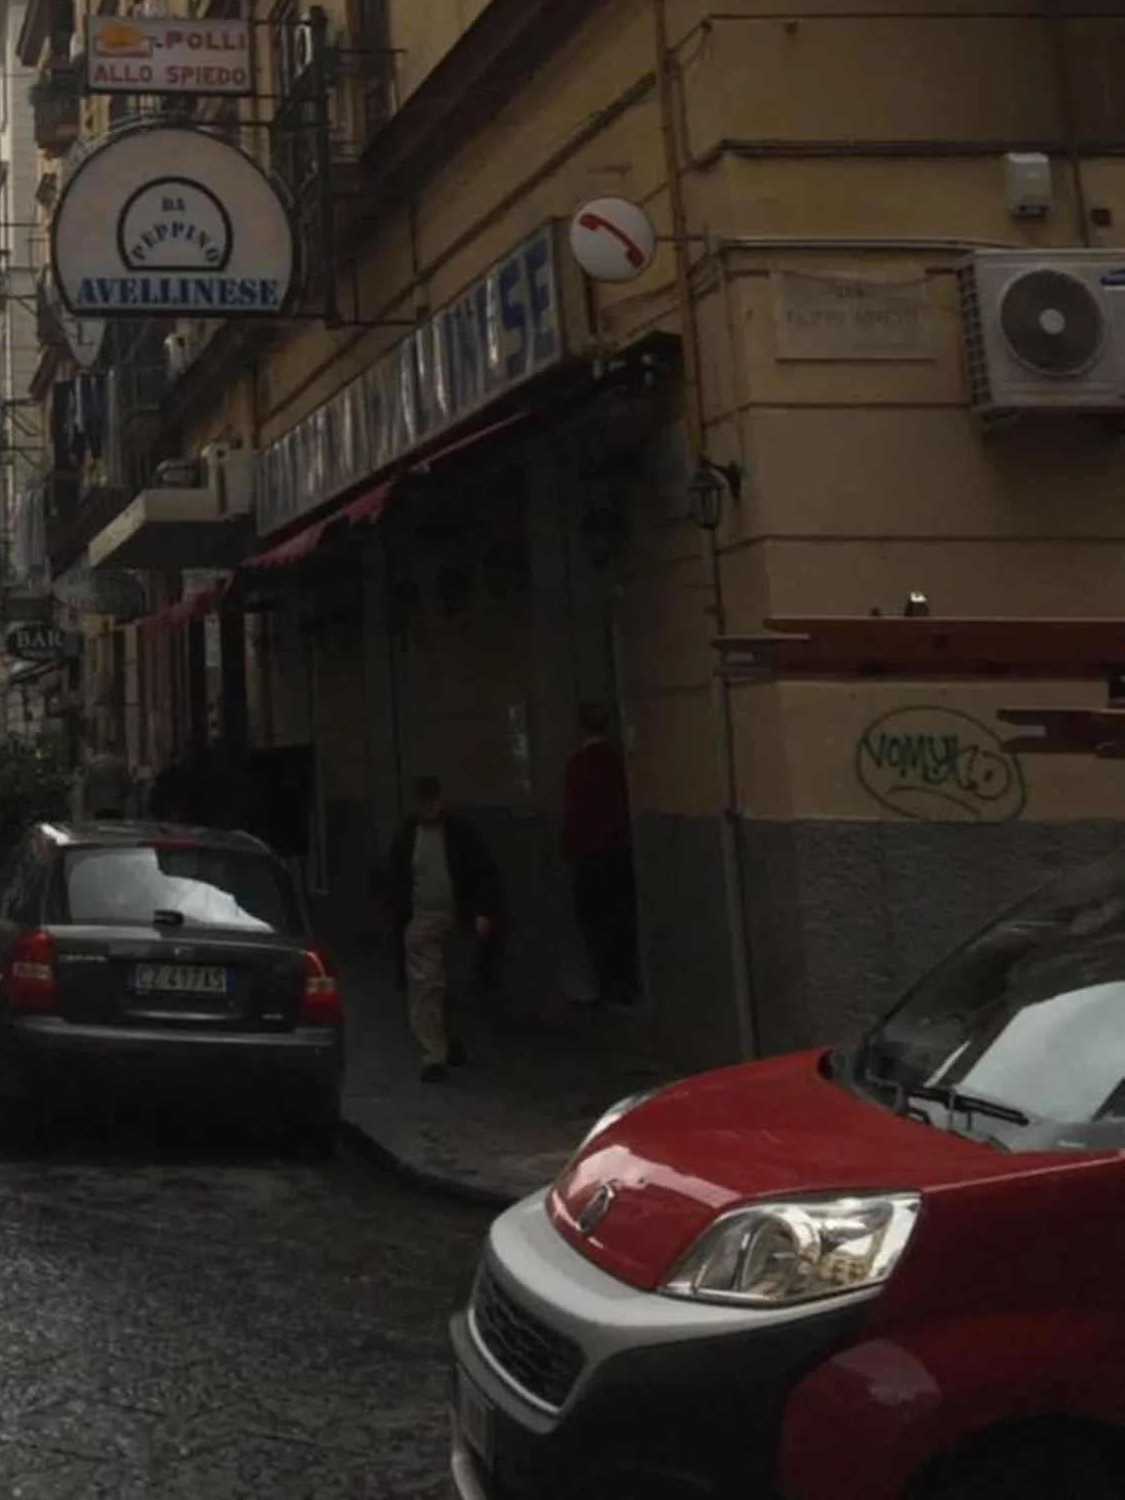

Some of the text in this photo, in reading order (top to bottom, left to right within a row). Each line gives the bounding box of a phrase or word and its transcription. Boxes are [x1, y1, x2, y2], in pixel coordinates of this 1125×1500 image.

[167, 30, 247, 51] POLLI
[94, 65, 247, 86] ALLO SPIEDO
[162, 197, 186, 211] DA
[131, 221, 219, 263] PEPPINO
[76, 277, 279, 306] AVELLINESE
